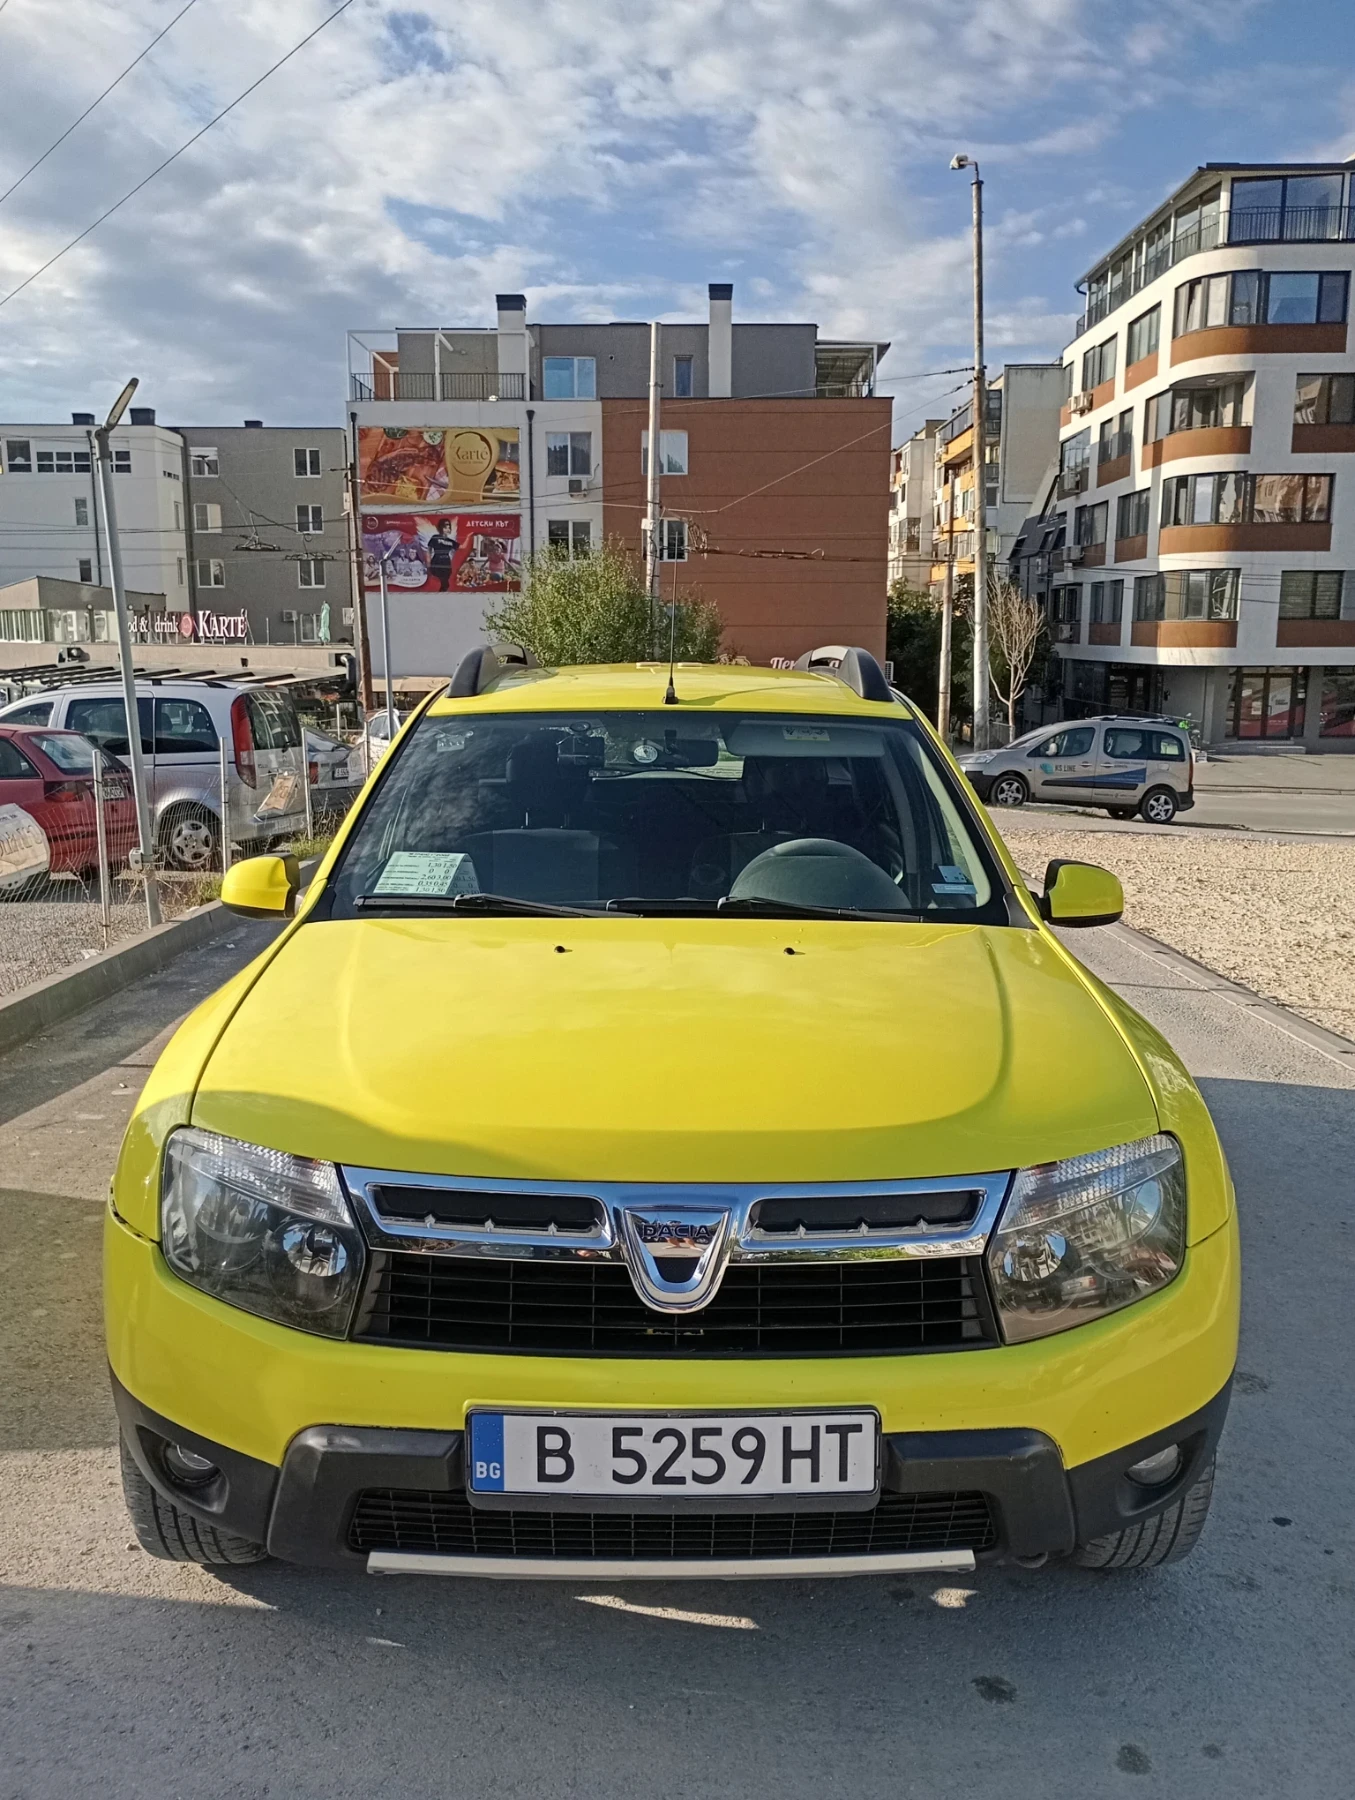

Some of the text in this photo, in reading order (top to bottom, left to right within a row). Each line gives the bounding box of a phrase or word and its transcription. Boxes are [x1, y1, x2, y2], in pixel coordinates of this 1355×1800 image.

[495, 520, 509, 528] КЪТ
[155, 615, 179, 633] drink
[198, 608, 247, 638] KARTÉ
[1063, 765, 1076, 773] LINE
[642, 1224, 711, 1239] DACIA
[536, 1423, 863, 1486] B 5259 HT
[475, 1462, 501, 1480] BG
